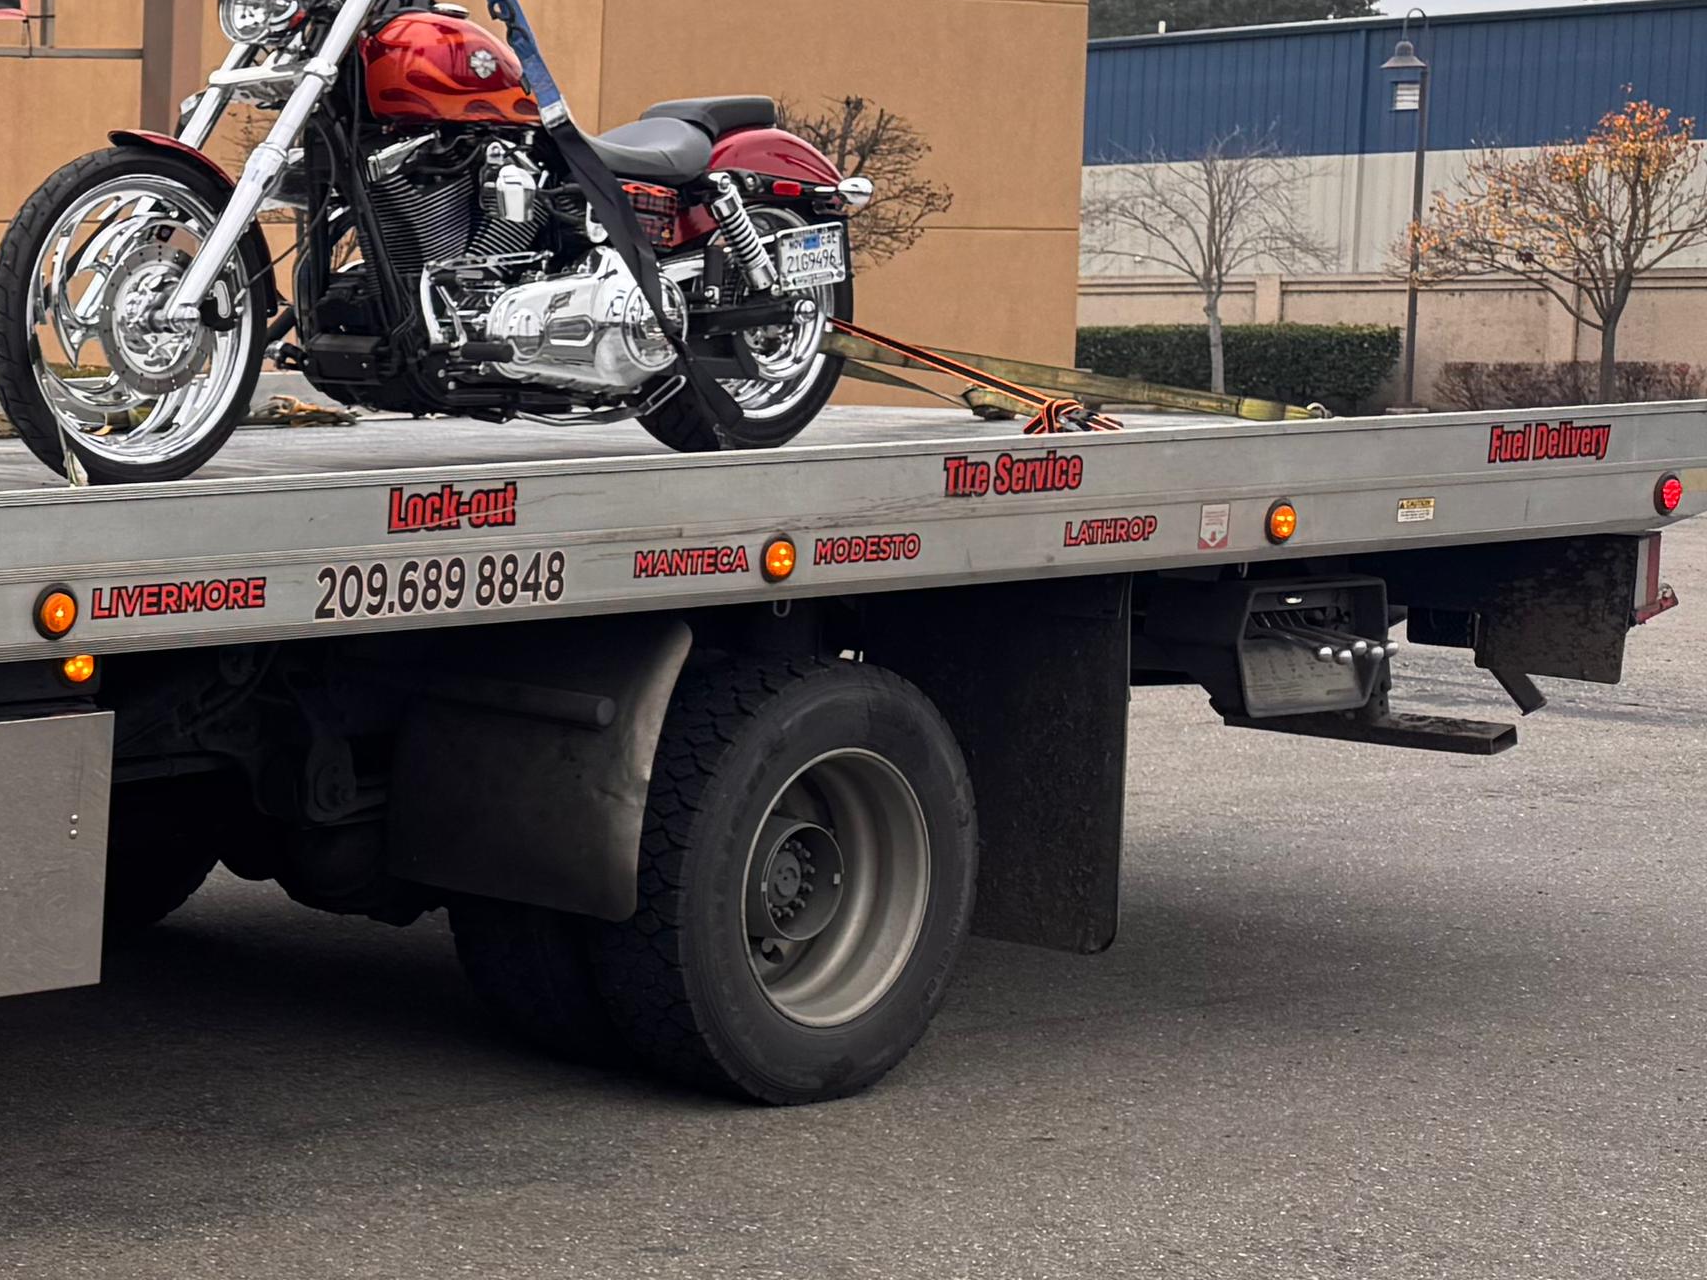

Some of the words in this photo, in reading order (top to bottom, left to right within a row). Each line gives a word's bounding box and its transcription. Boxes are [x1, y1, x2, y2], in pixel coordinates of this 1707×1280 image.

[1488, 423, 1532, 463] Fuel
[1533, 421, 1611, 460] Delivery
[944, 456, 990, 497] Tire
[994, 450, 1083, 495] Service
[388, 481, 518, 534] Lock-out
[814, 534, 921, 566] MODESTO
[1064, 516, 1157, 547] LATHROP
[634, 546, 748, 578] MANTECA
[91, 577, 267, 619] LIVERMORE
[315, 557, 465, 619] 209.689
[475, 551, 565, 607] 8848
